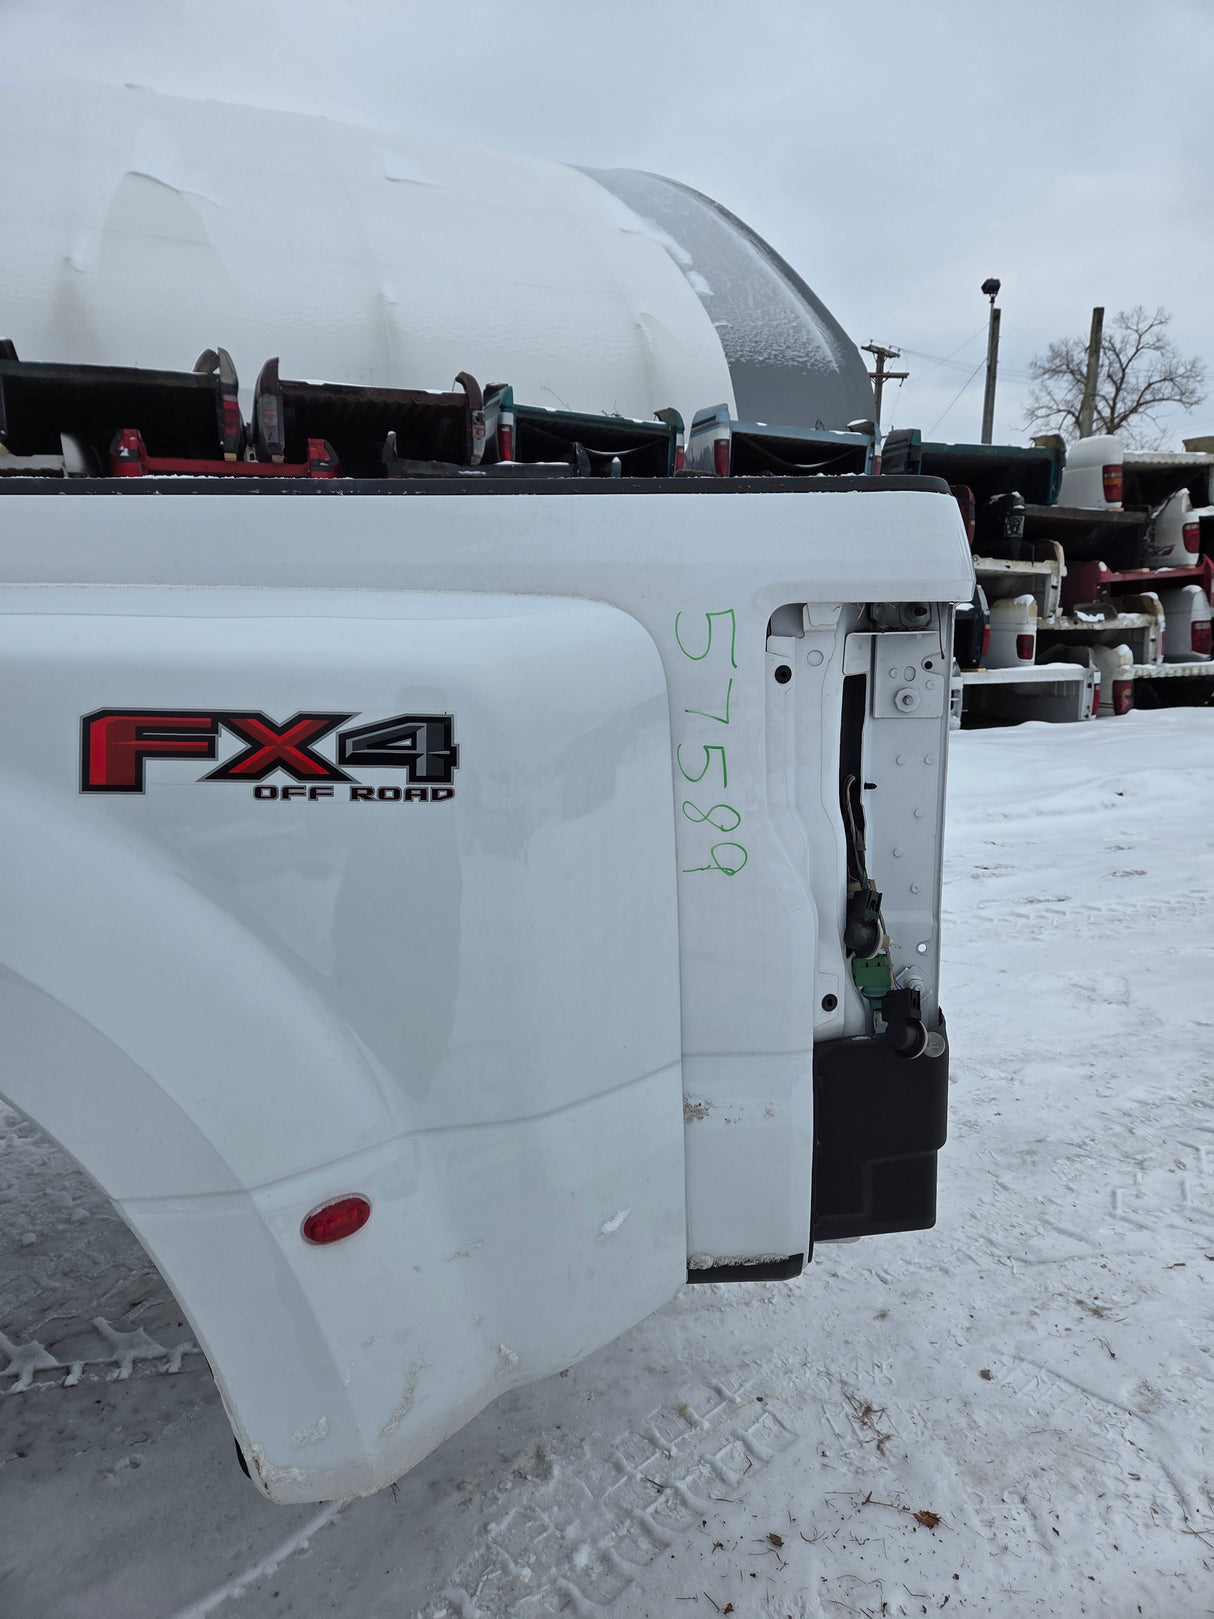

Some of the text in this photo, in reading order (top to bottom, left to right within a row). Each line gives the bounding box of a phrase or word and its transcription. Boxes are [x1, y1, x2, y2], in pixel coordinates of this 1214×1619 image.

[79, 707, 461, 794] FX4
[674, 608, 748, 877] 57589
[252, 784, 456, 802] OFF ROAD
